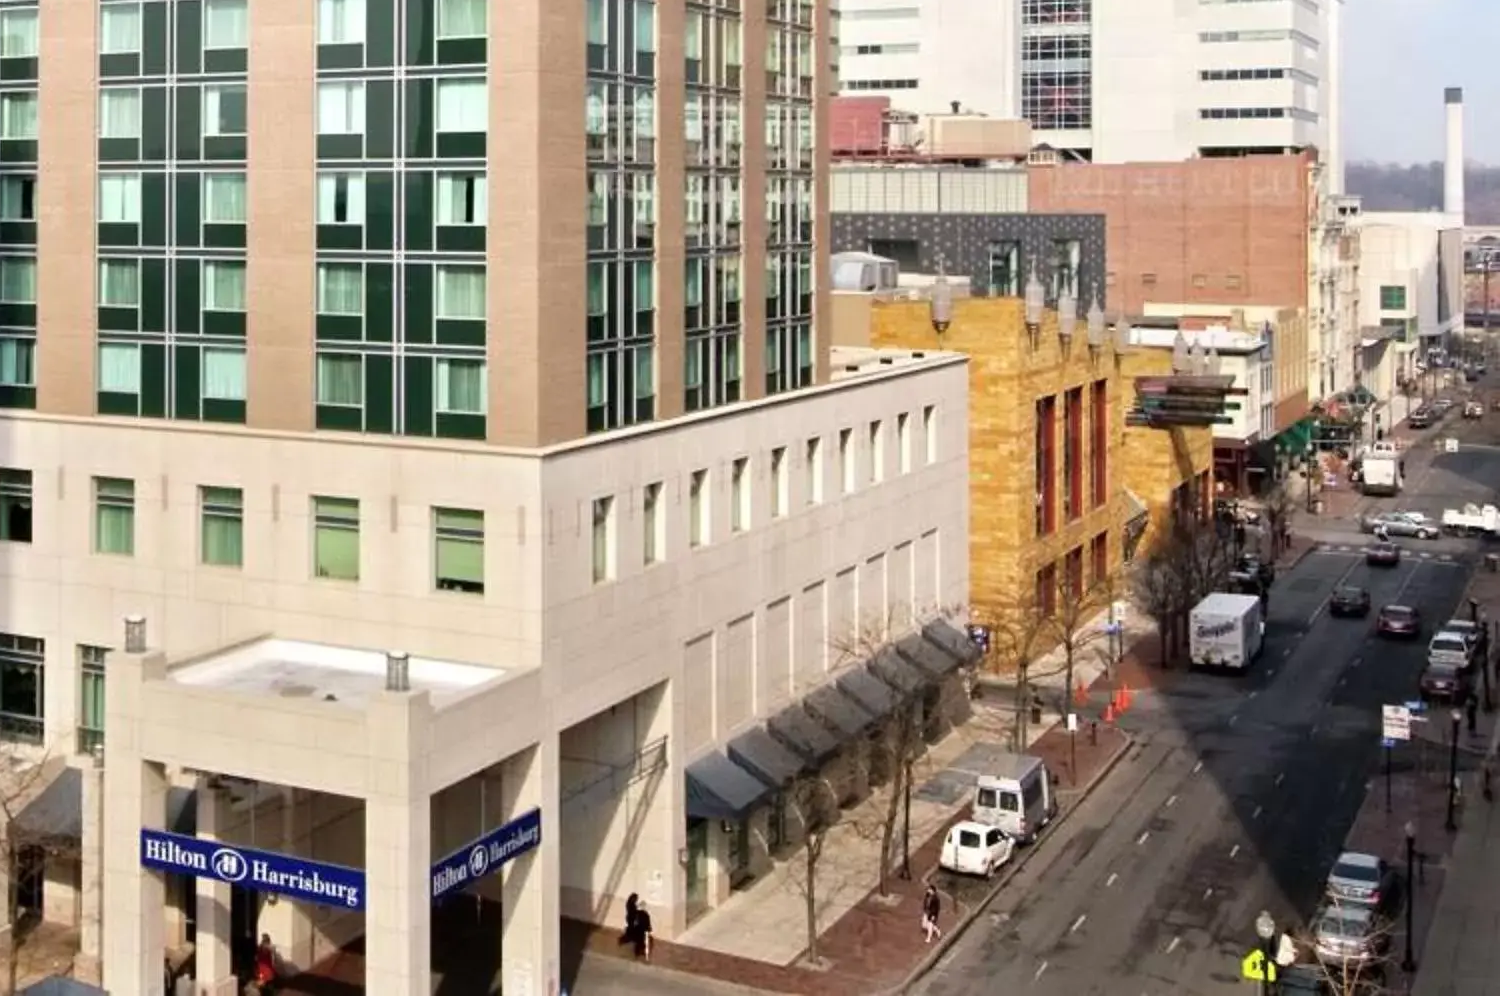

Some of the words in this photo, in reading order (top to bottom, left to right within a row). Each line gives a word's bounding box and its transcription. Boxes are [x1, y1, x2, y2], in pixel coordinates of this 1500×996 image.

[145, 838, 207, 870] Hilton
[252, 859, 359, 906] Harrisburg
[433, 864, 467, 897] Hilton
[490, 825, 538, 863] Harrisburg
